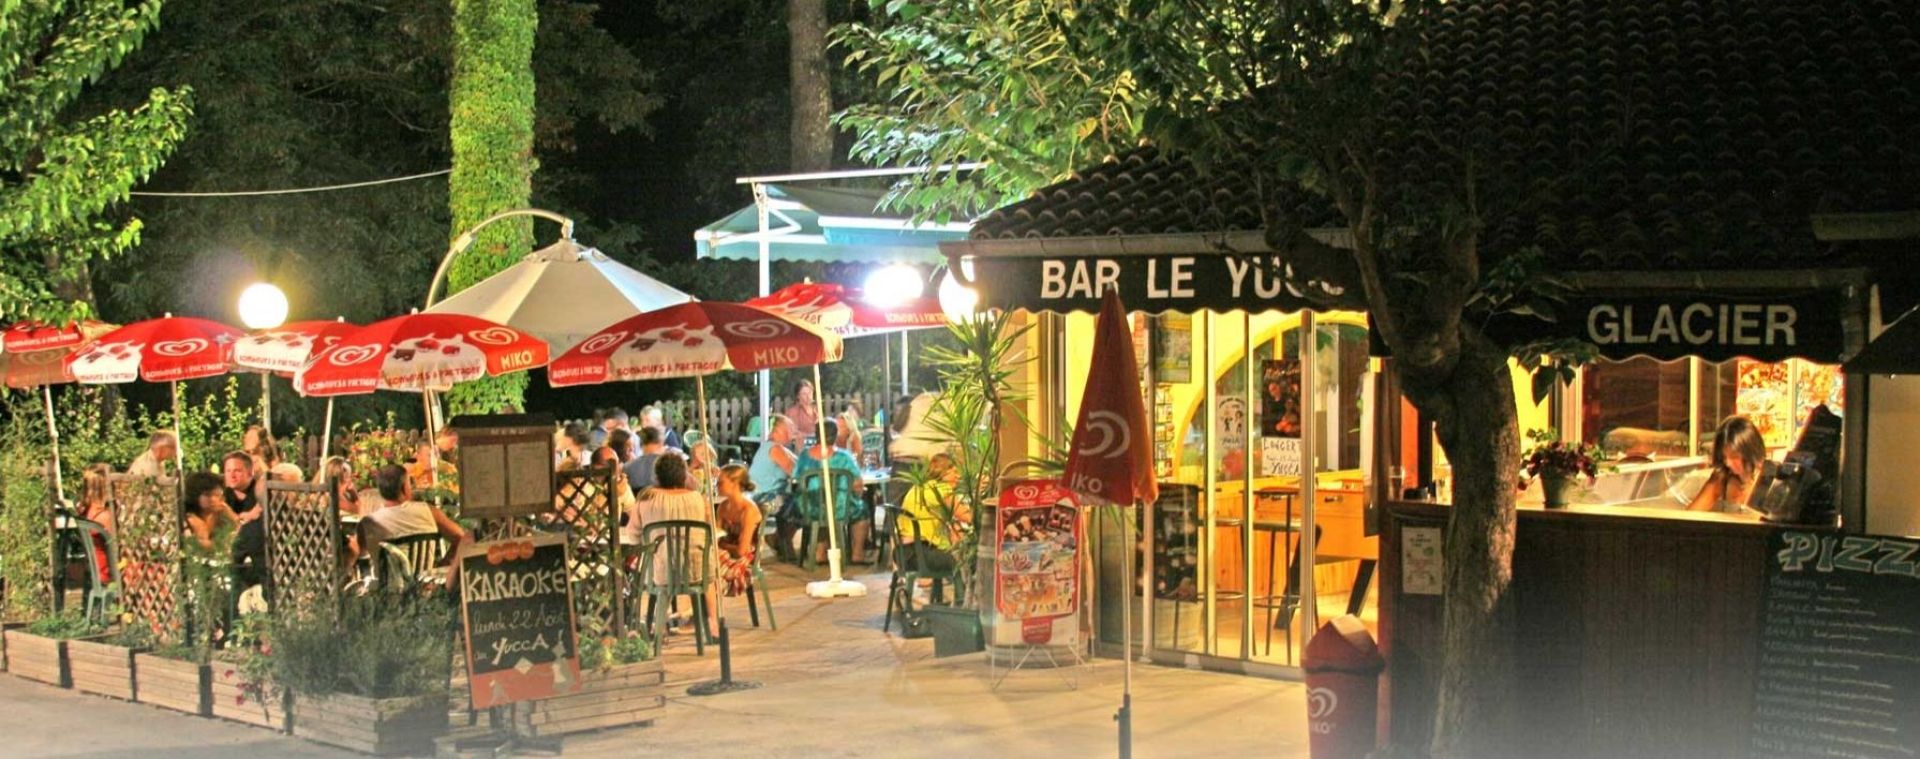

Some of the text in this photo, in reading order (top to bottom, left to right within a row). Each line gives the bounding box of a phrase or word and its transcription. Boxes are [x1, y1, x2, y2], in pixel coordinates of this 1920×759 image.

[1041, 259, 1121, 299] BAR
[1147, 257, 1196, 298] LE
[1587, 303, 1798, 345] GLACIER
[500, 350, 533, 371] MIKO
[754, 346, 799, 367] MIKO
[1070, 472, 1103, 494] IKO
[1777, 531, 1920, 578] PIZZ
[465, 560, 567, 602] KARAOKÉ
[508, 609, 534, 630] 22
